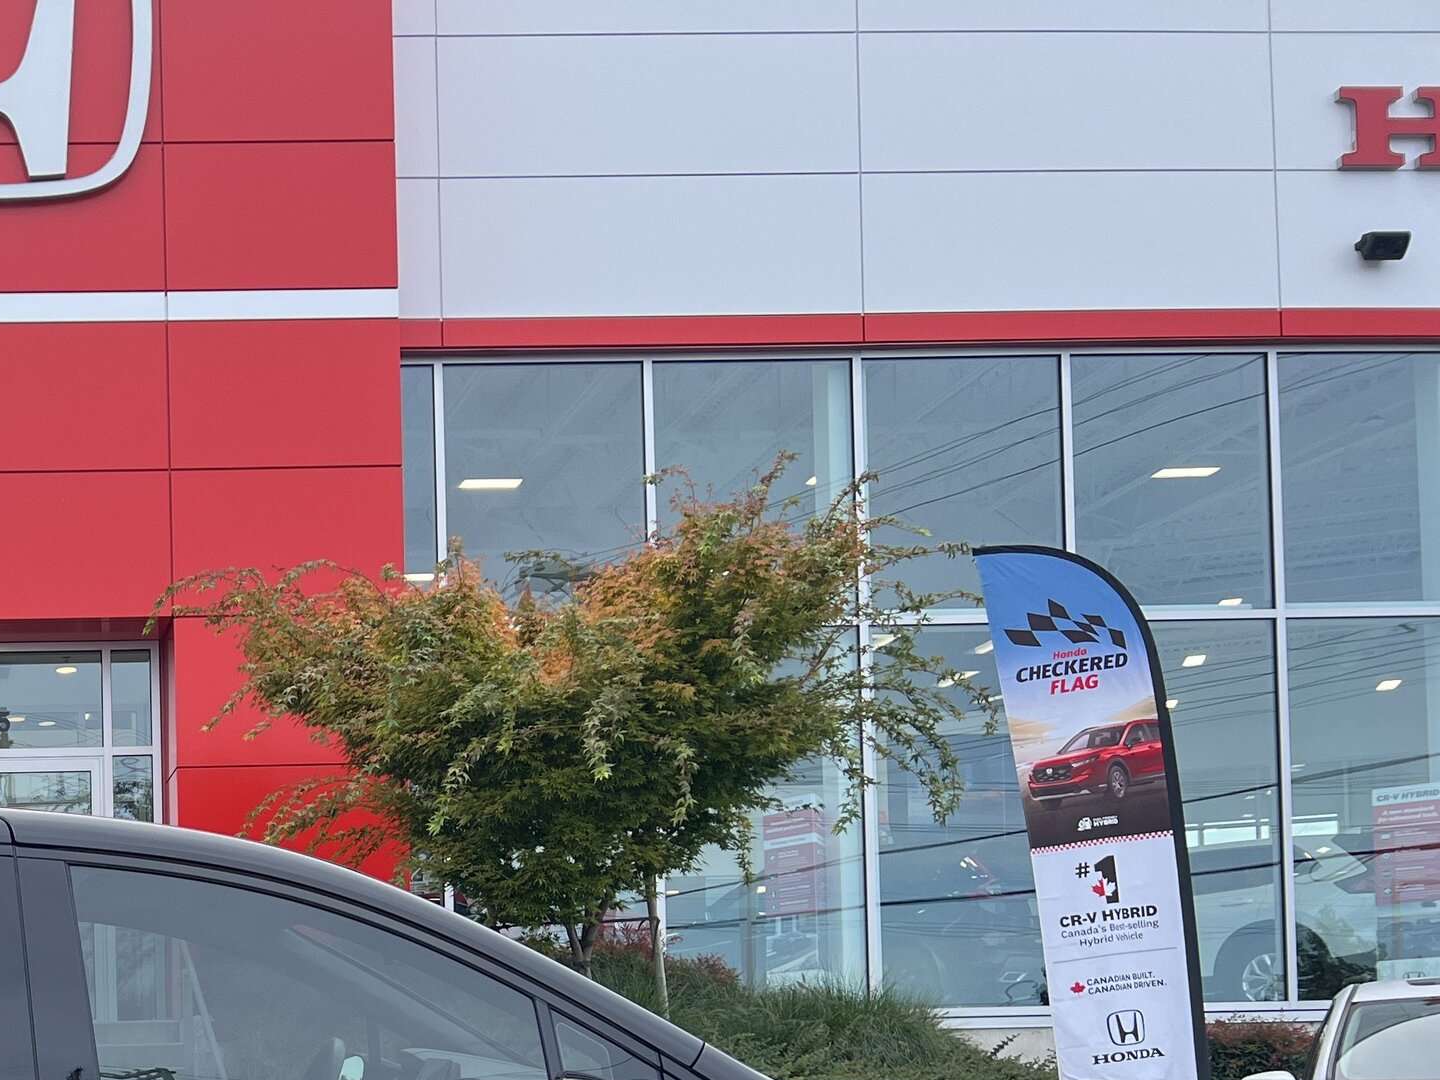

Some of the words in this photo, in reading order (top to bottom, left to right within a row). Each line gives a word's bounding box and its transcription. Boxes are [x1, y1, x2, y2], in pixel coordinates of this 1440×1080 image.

[1053, 647, 1088, 660] Honda
[1016, 652, 1128, 683] CHECKERED
[1050, 674, 1099, 695] FLAG
[1060, 911, 1097, 928] CR-V
[1101, 905, 1158, 921] HYBRID
[1061, 925, 1107, 939] Canada's
[1109, 919, 1159, 932] Best-selling
[1080, 934, 1113, 947] Hybrid
[1115, 931, 1143, 941] Vehicle
[1087, 974, 1131, 986] CANADIAN
[1132, 971, 1156, 980] BUILT.
[1088, 982, 1133, 995] CANADIAN
[1134, 979, 1168, 989] DRIVEN.
[1091, 1048, 1165, 1065] HONDA
